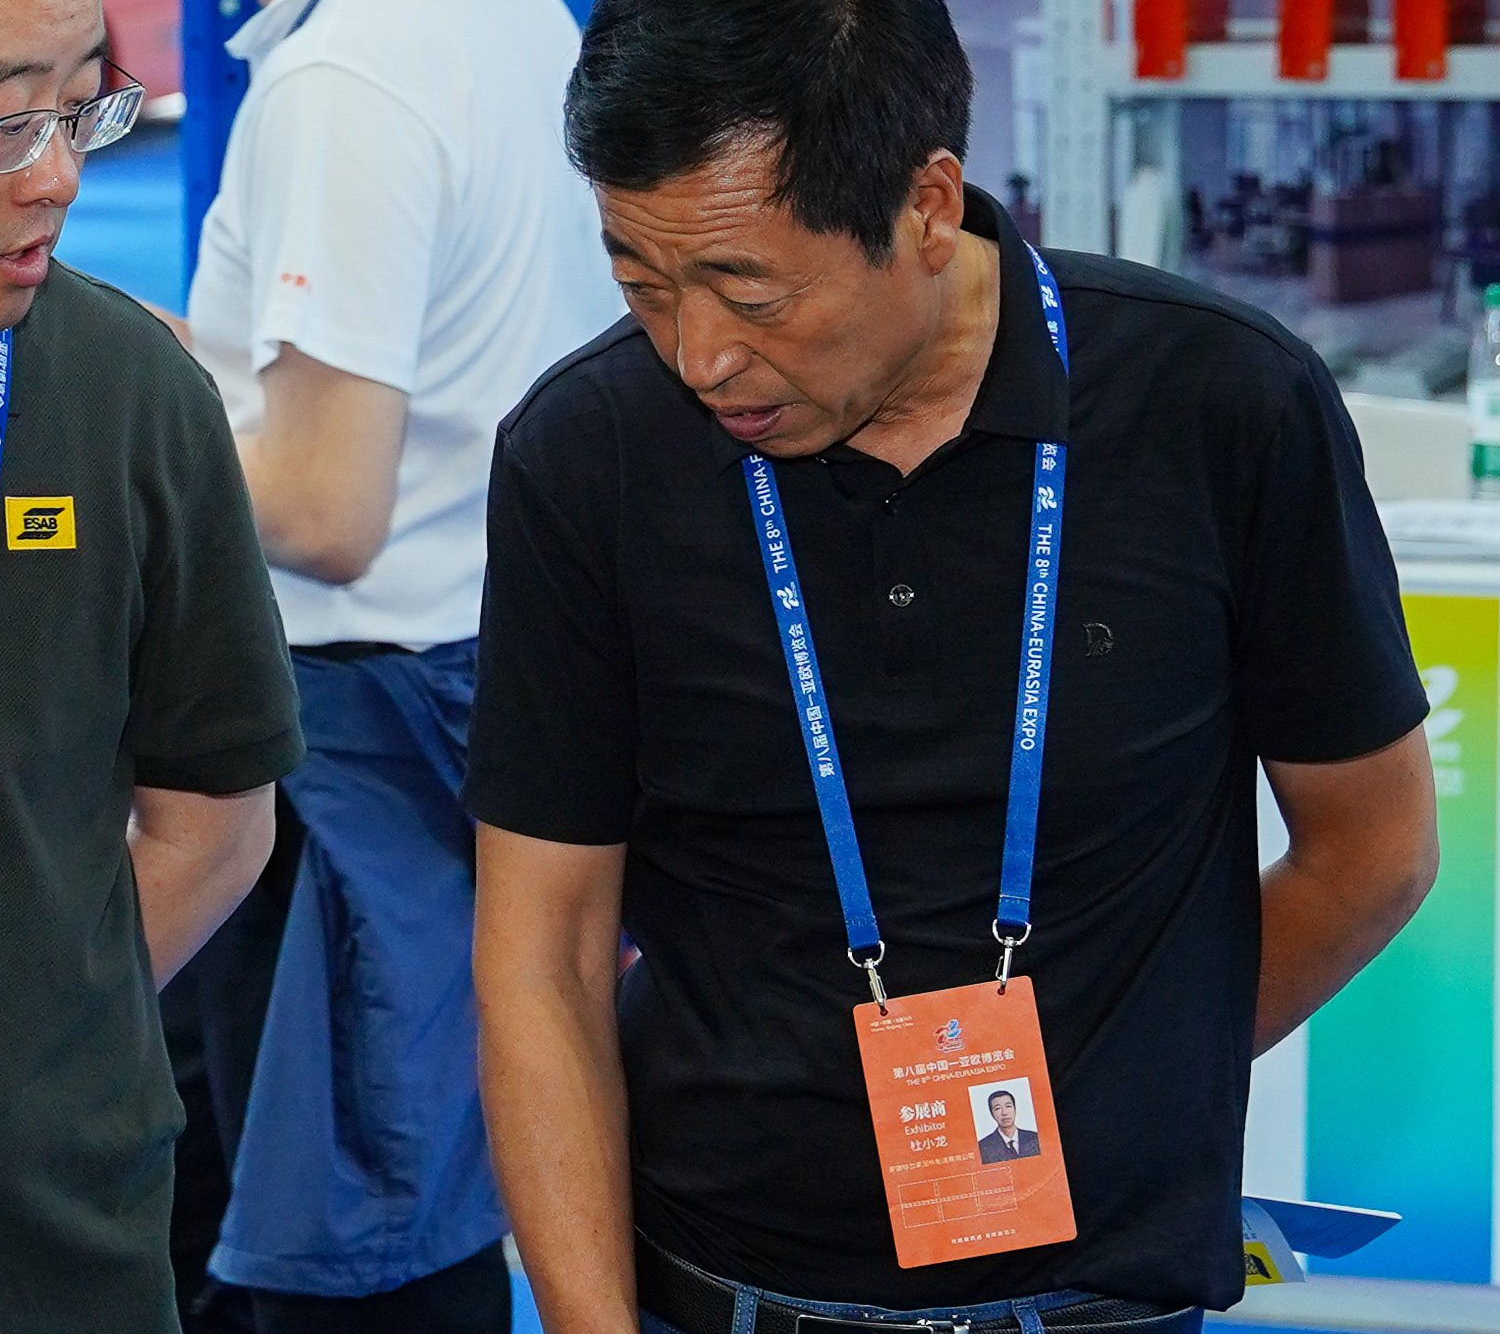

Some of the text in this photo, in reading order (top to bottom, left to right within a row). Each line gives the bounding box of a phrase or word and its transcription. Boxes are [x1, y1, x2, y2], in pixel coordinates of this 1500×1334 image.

[23, 517, 58, 530] ESAB
[766, 521, 780, 538] 8th
[769, 541, 787, 573] THE
[1021, 524, 1052, 750] THE 8th CHINA-EURASIA EXPO
[899, 1099, 947, 1123] 参展商
[904, 1122, 946, 1136] Exhibitor
